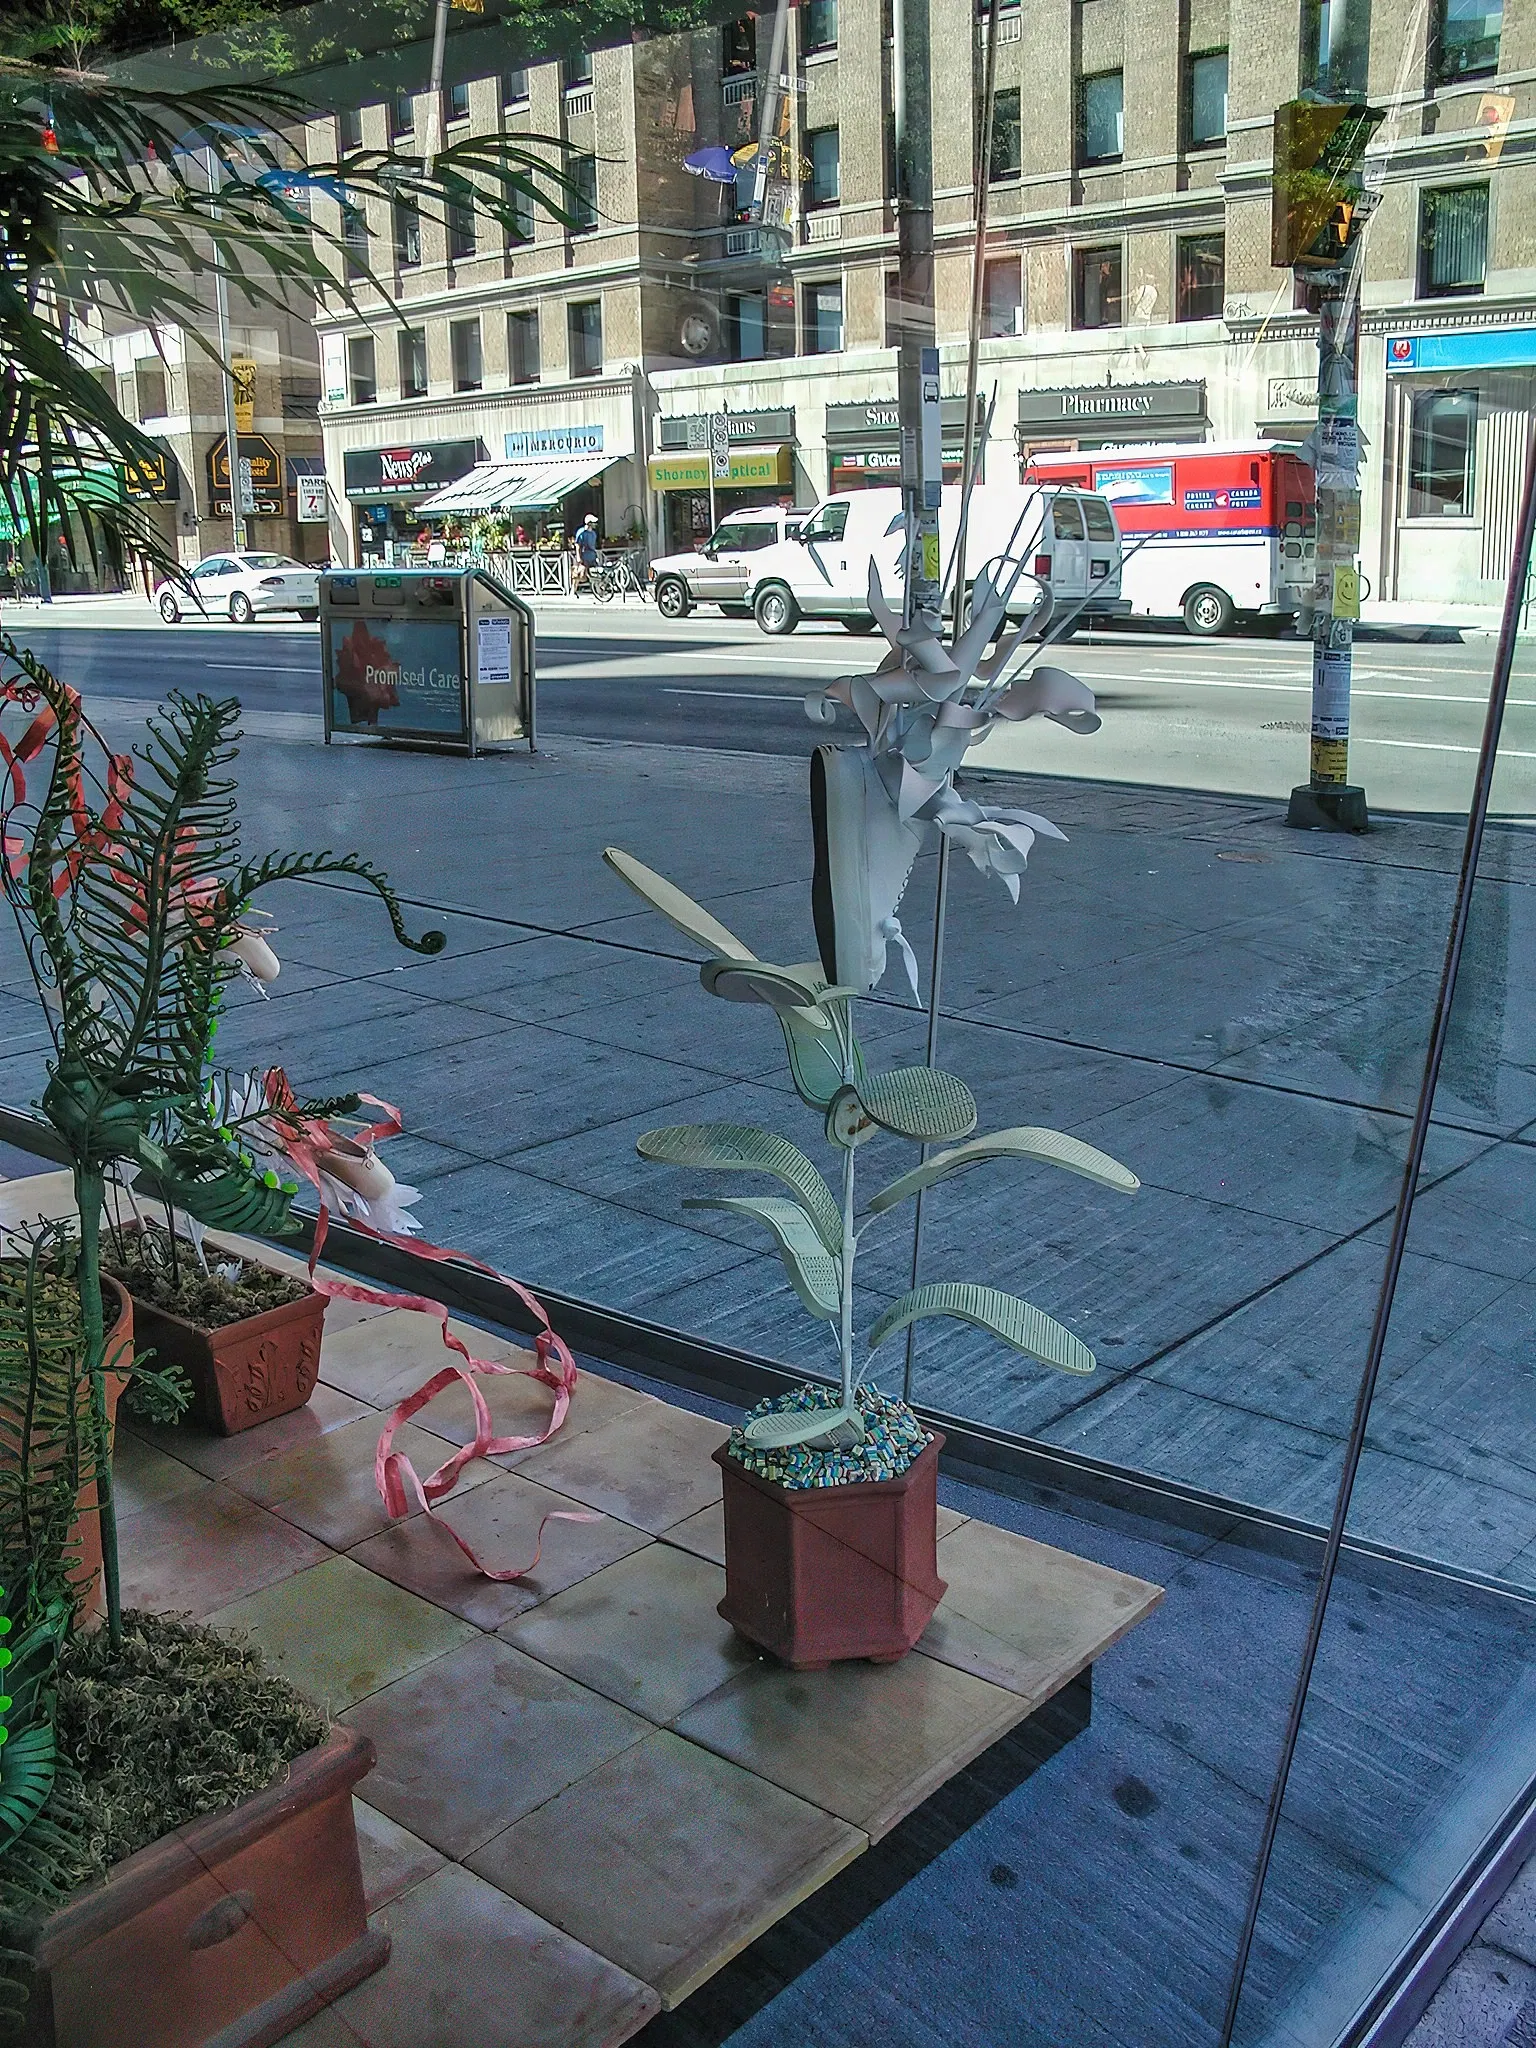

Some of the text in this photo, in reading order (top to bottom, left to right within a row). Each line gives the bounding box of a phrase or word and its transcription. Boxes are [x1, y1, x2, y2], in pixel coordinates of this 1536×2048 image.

[1061, 394, 1153, 416] Pharmacy
[530, 435, 597, 452] MERCURIO
[380, 454, 414, 480] News
[655, 468, 707, 482] Shorney
[731, 463, 771, 479] ptical
[365, 665, 460, 689] Promised Care
